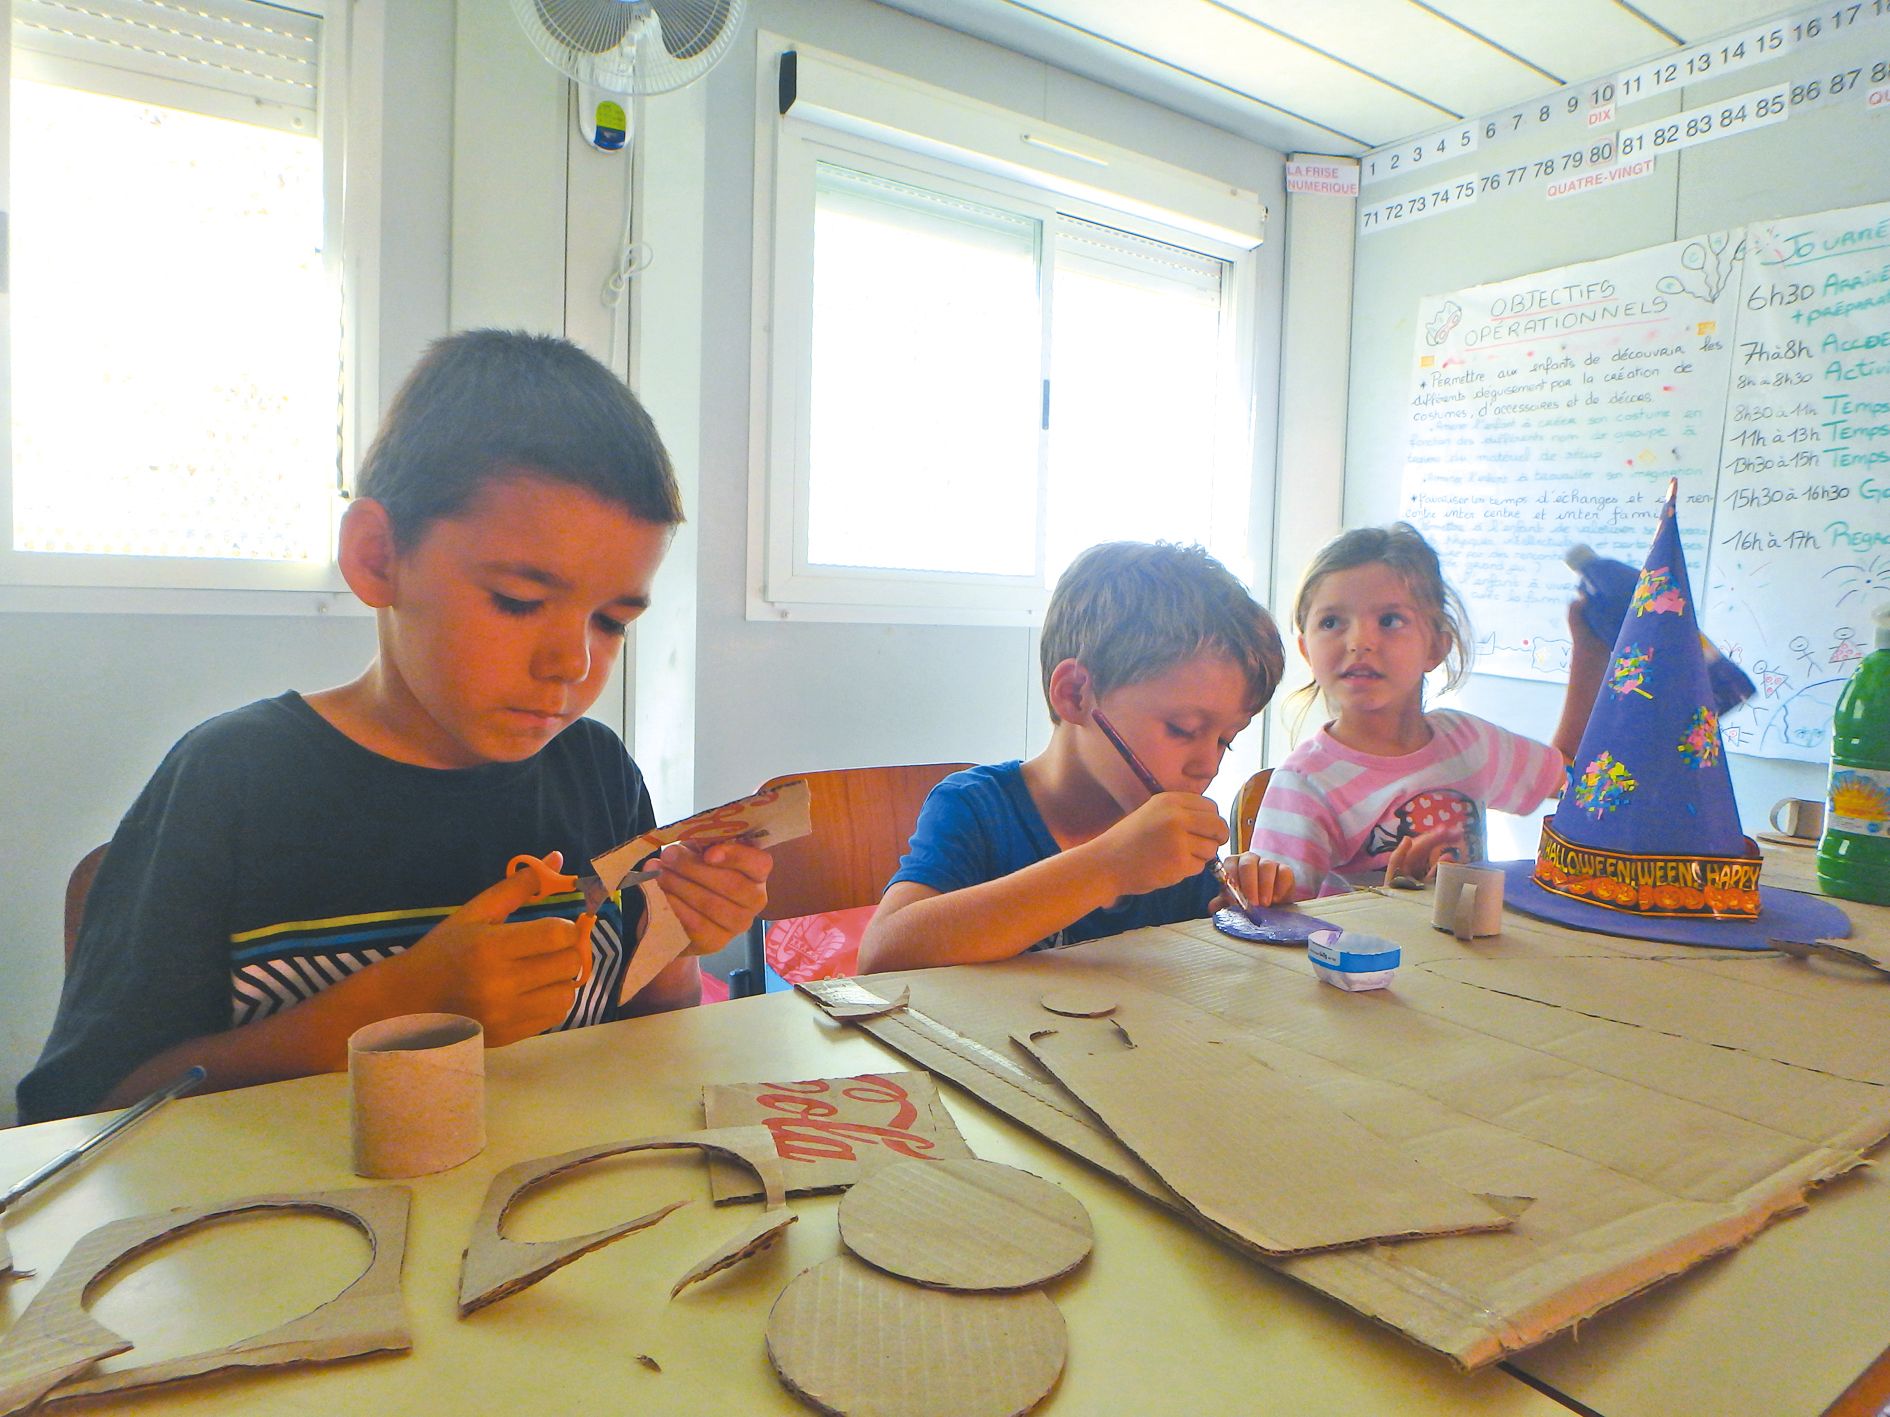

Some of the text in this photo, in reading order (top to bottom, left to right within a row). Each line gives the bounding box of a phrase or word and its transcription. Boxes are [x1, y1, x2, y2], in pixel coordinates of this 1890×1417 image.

[1370, 162, 1377, 176] 1
[1391, 154, 1400, 170] 2
[1413, 146, 1422, 162] 3
[1437, 138, 1446, 153] 4
[1461, 131, 1471, 147] 5
[1486, 122, 1496, 139] 6
[1512, 113, 1523, 131] 7
[1539, 105, 1550, 122] 8
[1567, 96, 1579, 113] 9
[1591, 85, 1615, 105] 10
[1622, 75, 1641, 96] 11
[1653, 63, 1677, 86] 12
[1686, 53, 1711, 75] 13
[1720, 41, 1746, 65] 14
[1756, 28, 1784, 53] 15
[1792, 17, 1822, 42] 16
[1831, 3, 1862, 30] 17
[1588, 109, 1612, 126] DIX
[1363, 211, 1379, 228] 71
[1385, 203, 1403, 221] 72
[1408, 197, 1427, 214] 73
[1432, 189, 1450, 207] 74
[1455, 181, 1475, 200] 75
[1480, 173, 1501, 193] 76
[1506, 167, 1528, 186] 77
[1533, 160, 1555, 178] 78
[1561, 151, 1584, 171] 79
[1589, 143, 1612, 164] 80
[1622, 134, 1644, 156] 81
[1653, 125, 1680, 146] 82
[1686, 115, 1712, 137] 83
[1719, 104, 1747, 129] 84
[1755, 94, 1785, 119] 85
[1789, 80, 1822, 106] 86
[1829, 68, 1863, 95] 87
[1287, 166, 1339, 179] LA FRISE
[1547, 159, 1653, 197] QUATRE-VINGT
[1287, 179, 1358, 194] NUMERIQUE
[1490, 278, 1616, 318] OBJECTIFS
[1747, 283, 1815, 311] 6h30
[1583, 351, 1600, 366] de
[1583, 372, 1594, 384] la
[1673, 360, 1693, 375] de
[1566, 394, 1578, 407] et
[1585, 391, 1600, 406] de
[1730, 429, 1767, 447] 11h
[1625, 491, 1641, 504] et
[1723, 487, 1784, 511] 15h30
[1801, 484, 1850, 502] 16h30
[1534, 508, 1546, 520] et
[1722, 530, 1764, 551] 16h
[1784, 529, 1821, 550] 17h
[1706, 862, 1760, 891] HAPPY
